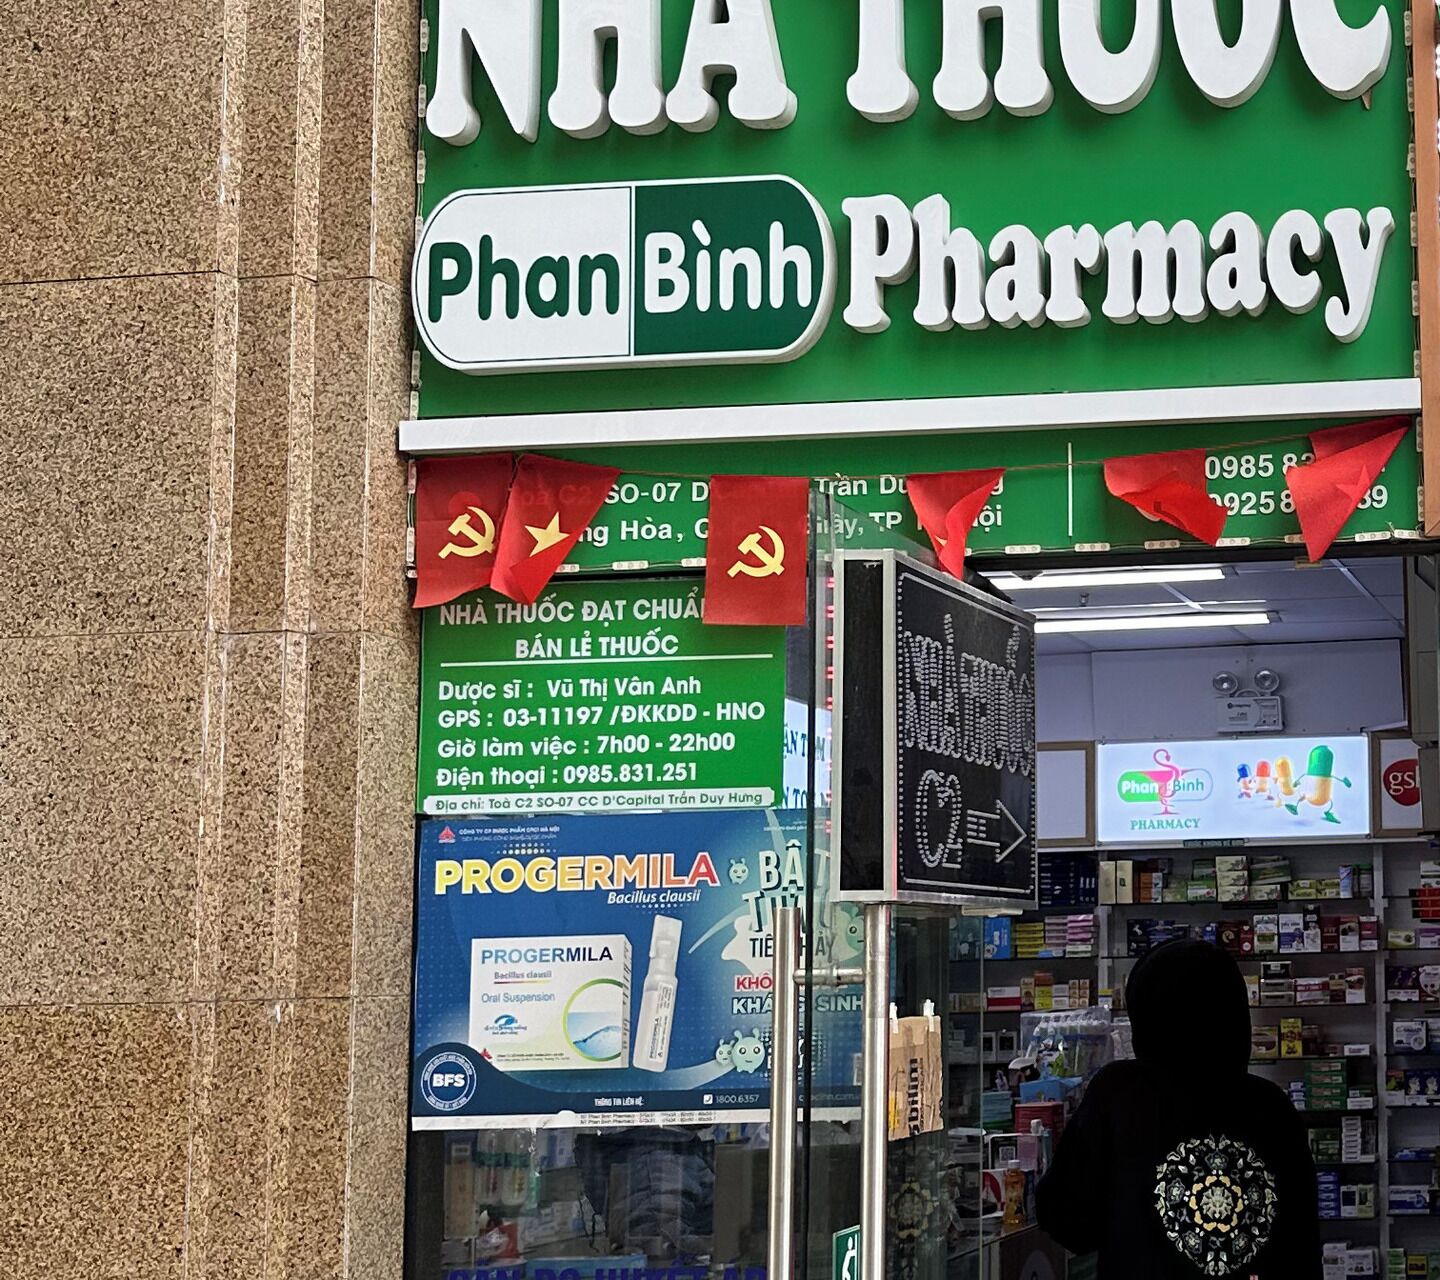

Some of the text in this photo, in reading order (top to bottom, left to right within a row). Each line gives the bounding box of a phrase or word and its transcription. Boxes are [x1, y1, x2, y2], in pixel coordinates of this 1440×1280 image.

[428, 192, 1393, 342] Phan Bình Pharmacy
[1205, 453, 1273, 479] 0985
[869, 512, 902, 532] TP
[440, 587, 705, 627] NHÀ THUỐC ĐẠT CHUẨ
[516, 627, 678, 659] BÁN LẺ THUỐC
[439, 676, 701, 705] Dược sĩ Vũ Thị Vân Anh
[438, 710, 480, 728] GPS
[503, 706, 603, 727] 03-11197
[716, 702, 765, 720] HNO
[438, 732, 735, 760] Giờ làm việc 7h00 22h00
[436, 762, 697, 791] Điện thoại 0985.831.251
[1122, 778, 1204, 794] Phan Bình
[489, 798, 510, 809] Toà
[515, 798, 532, 808] C2
[578, 796, 598, 806] CC
[603, 794, 664, 806] D'Capital
[700, 793, 724, 806] Duy
[729, 792, 762, 804] Hưng
[1131, 818, 1200, 830] PHARMACY
[434, 851, 721, 895] PROGERMILA
[608, 889, 702, 904] Bacillus clausii
[481, 947, 613, 964] PROGERMILA
[481, 992, 555, 1004] Oral Suspension
[432, 1074, 465, 1088] BFS
[716, 1094, 759, 1104] 1800.6357
